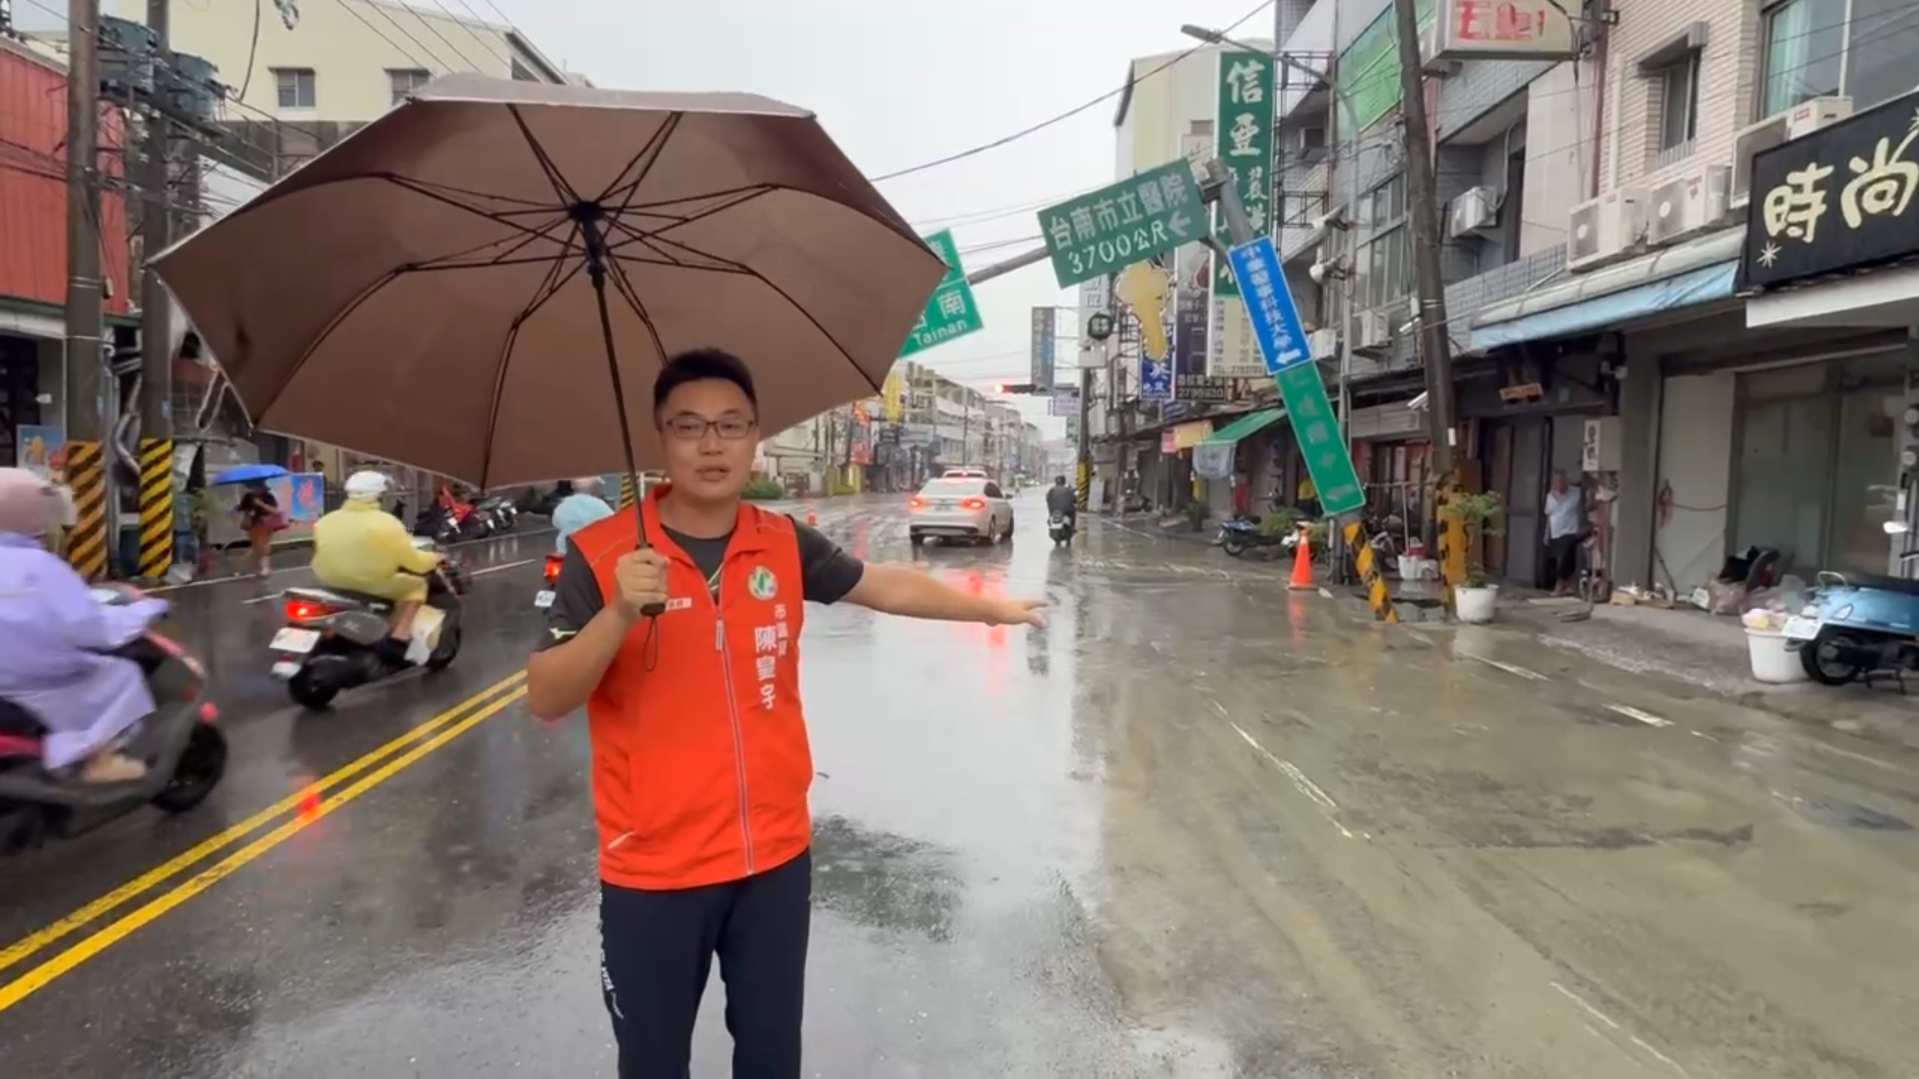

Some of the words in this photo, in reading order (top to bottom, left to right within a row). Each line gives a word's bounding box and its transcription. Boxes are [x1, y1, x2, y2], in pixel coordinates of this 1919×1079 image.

[1050, 173, 1188, 250] 台南市立醫院
[1763, 128, 1919, 243] 時尚
[1068, 219, 1168, 274] 3700公尺
[911, 319, 967, 346] Tainan
